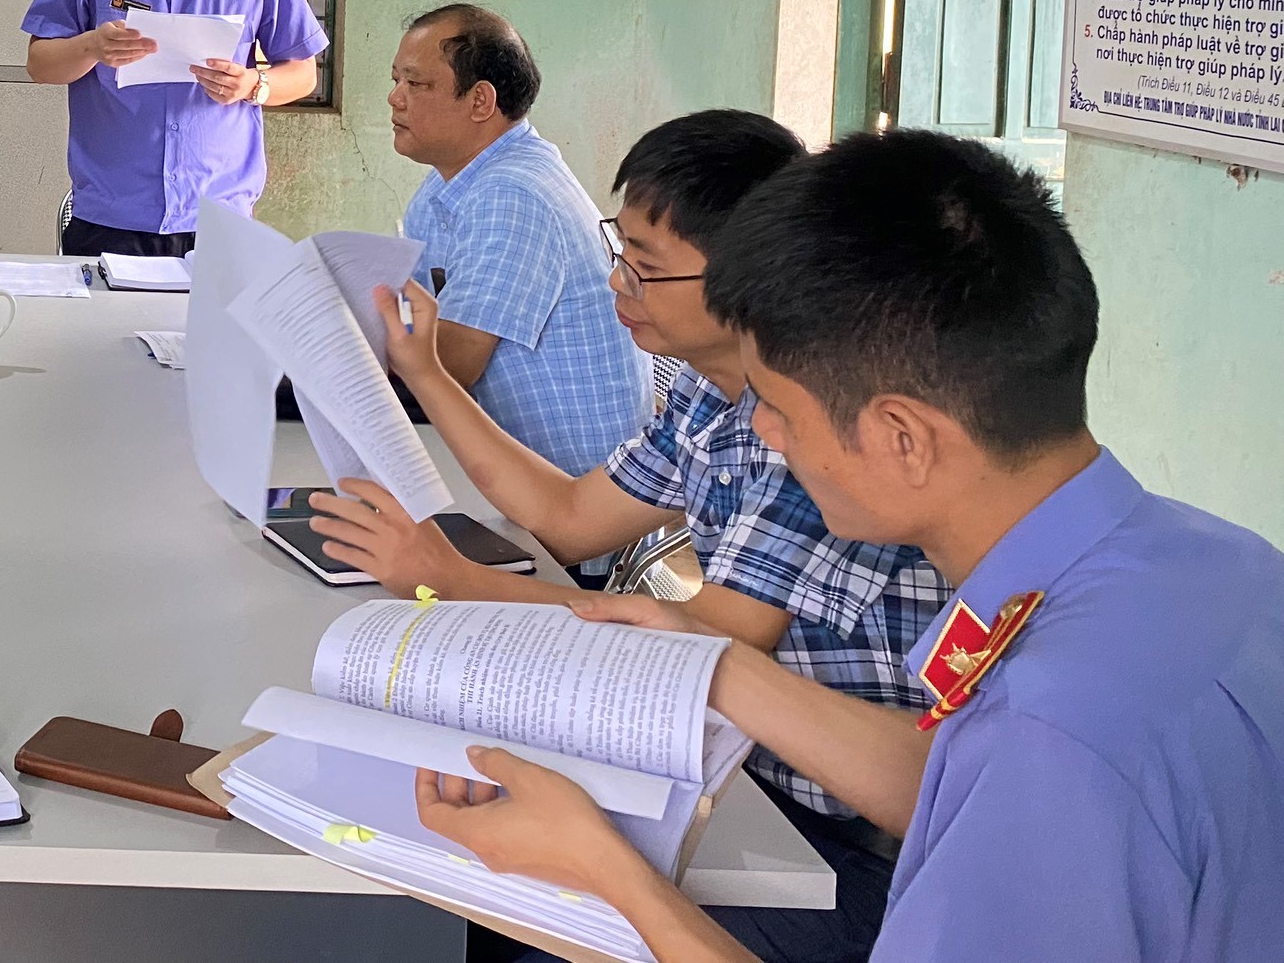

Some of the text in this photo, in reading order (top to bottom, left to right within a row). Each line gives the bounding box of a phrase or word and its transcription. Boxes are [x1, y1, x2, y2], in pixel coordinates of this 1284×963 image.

[1096, 46, 1114, 60] nơi
[1116, 47, 1143, 66] thực
[1146, 50, 1171, 70] hiện
[1175, 54, 1195, 74] trợ
[1197, 57, 1227, 79] giúp
[1230, 61, 1265, 83] pháp
